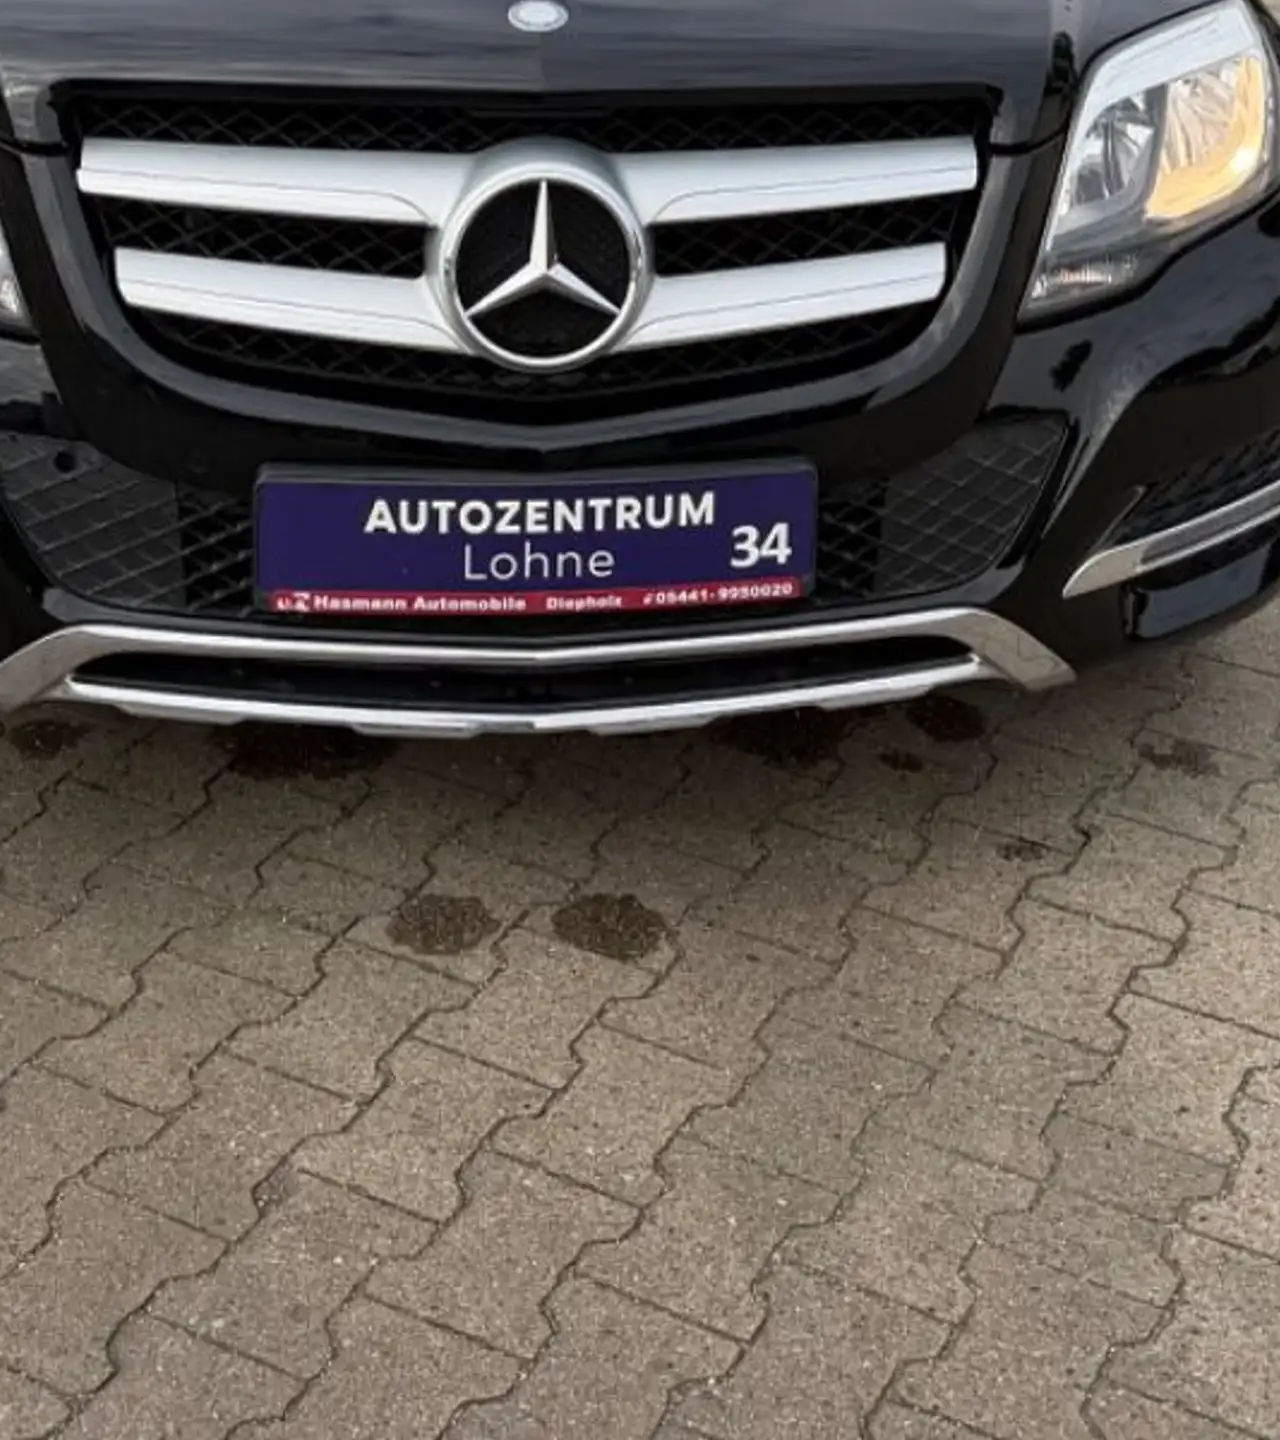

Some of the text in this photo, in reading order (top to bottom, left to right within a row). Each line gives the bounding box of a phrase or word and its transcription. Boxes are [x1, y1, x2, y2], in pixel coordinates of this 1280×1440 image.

[364, 491, 716, 535] AUTOZENTRUM
[463, 542, 616, 582] Lohne
[730, 522, 792, 569] 34
